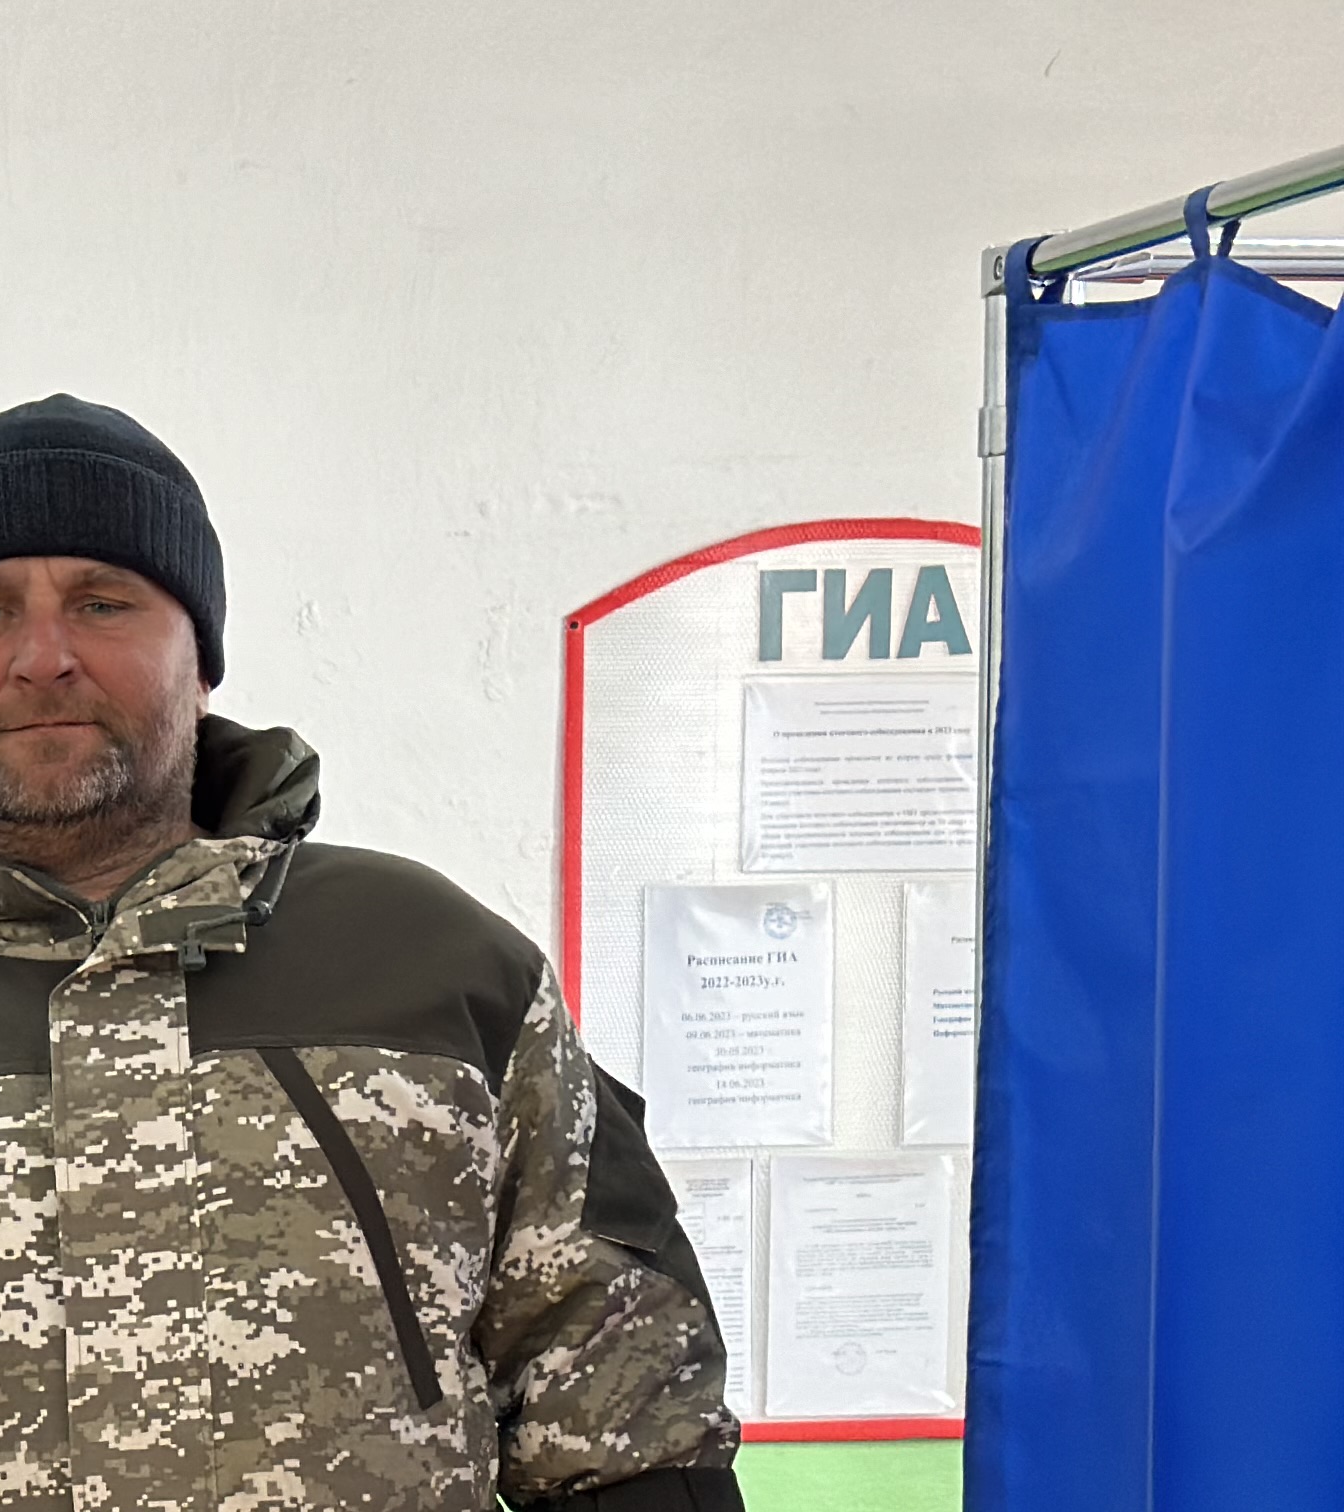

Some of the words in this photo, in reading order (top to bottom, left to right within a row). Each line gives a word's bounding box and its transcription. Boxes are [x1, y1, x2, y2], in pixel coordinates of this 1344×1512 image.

[758, 565, 974, 662] ГИА
[686, 953, 764, 967] Расписание
[767, 951, 798, 964] ГИА
